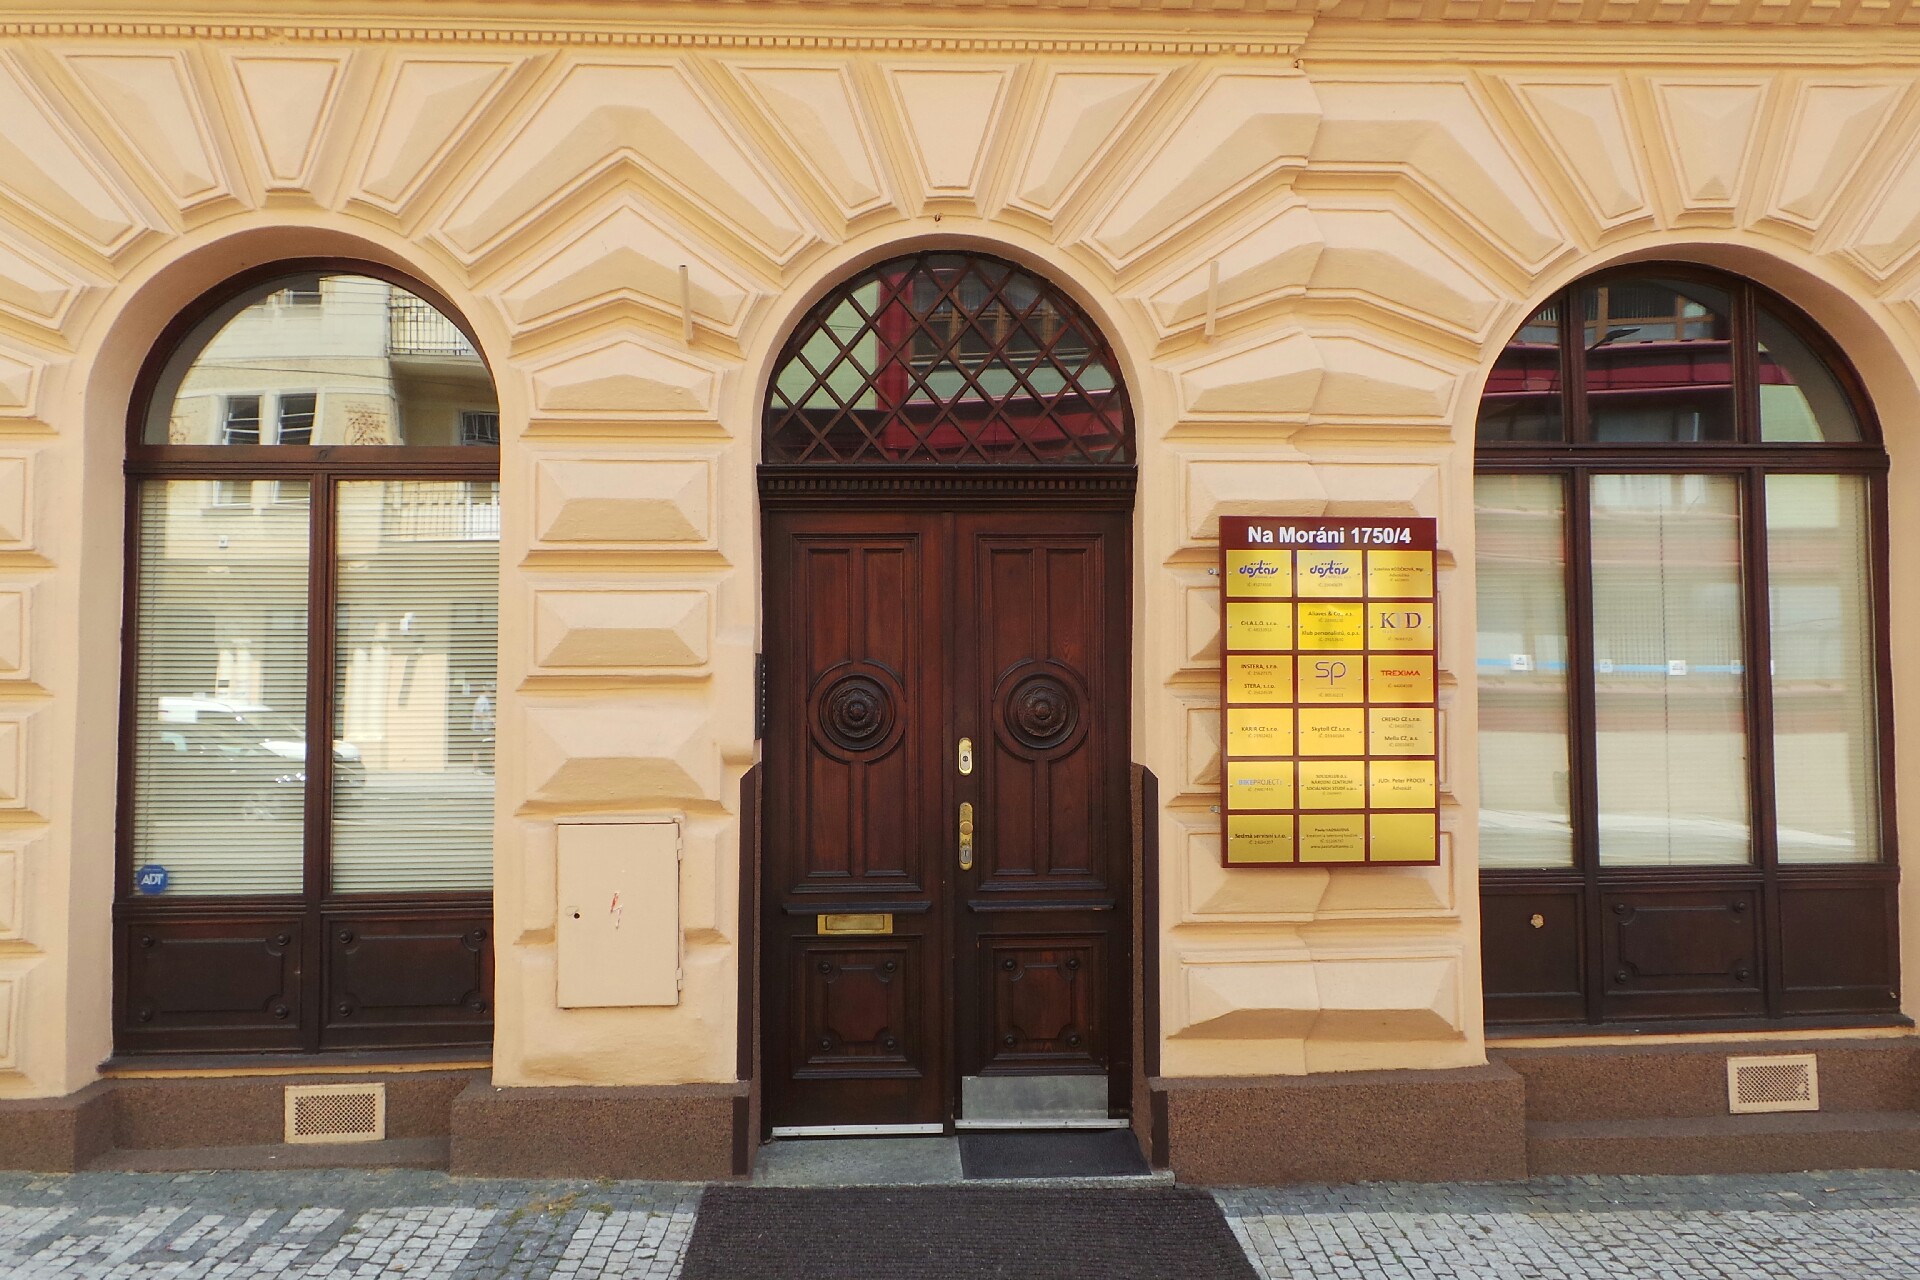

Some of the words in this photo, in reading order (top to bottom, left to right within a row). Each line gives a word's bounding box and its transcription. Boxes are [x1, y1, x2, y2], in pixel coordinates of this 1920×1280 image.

[1248, 526, 1274, 543] Na
[1279, 526, 1345, 543] Moráni
[1351, 527, 1412, 544] 1750/4
[1239, 560, 1279, 578] dostav
[1309, 560, 1350, 578] dostav
[140, 873, 164, 886] ADT
